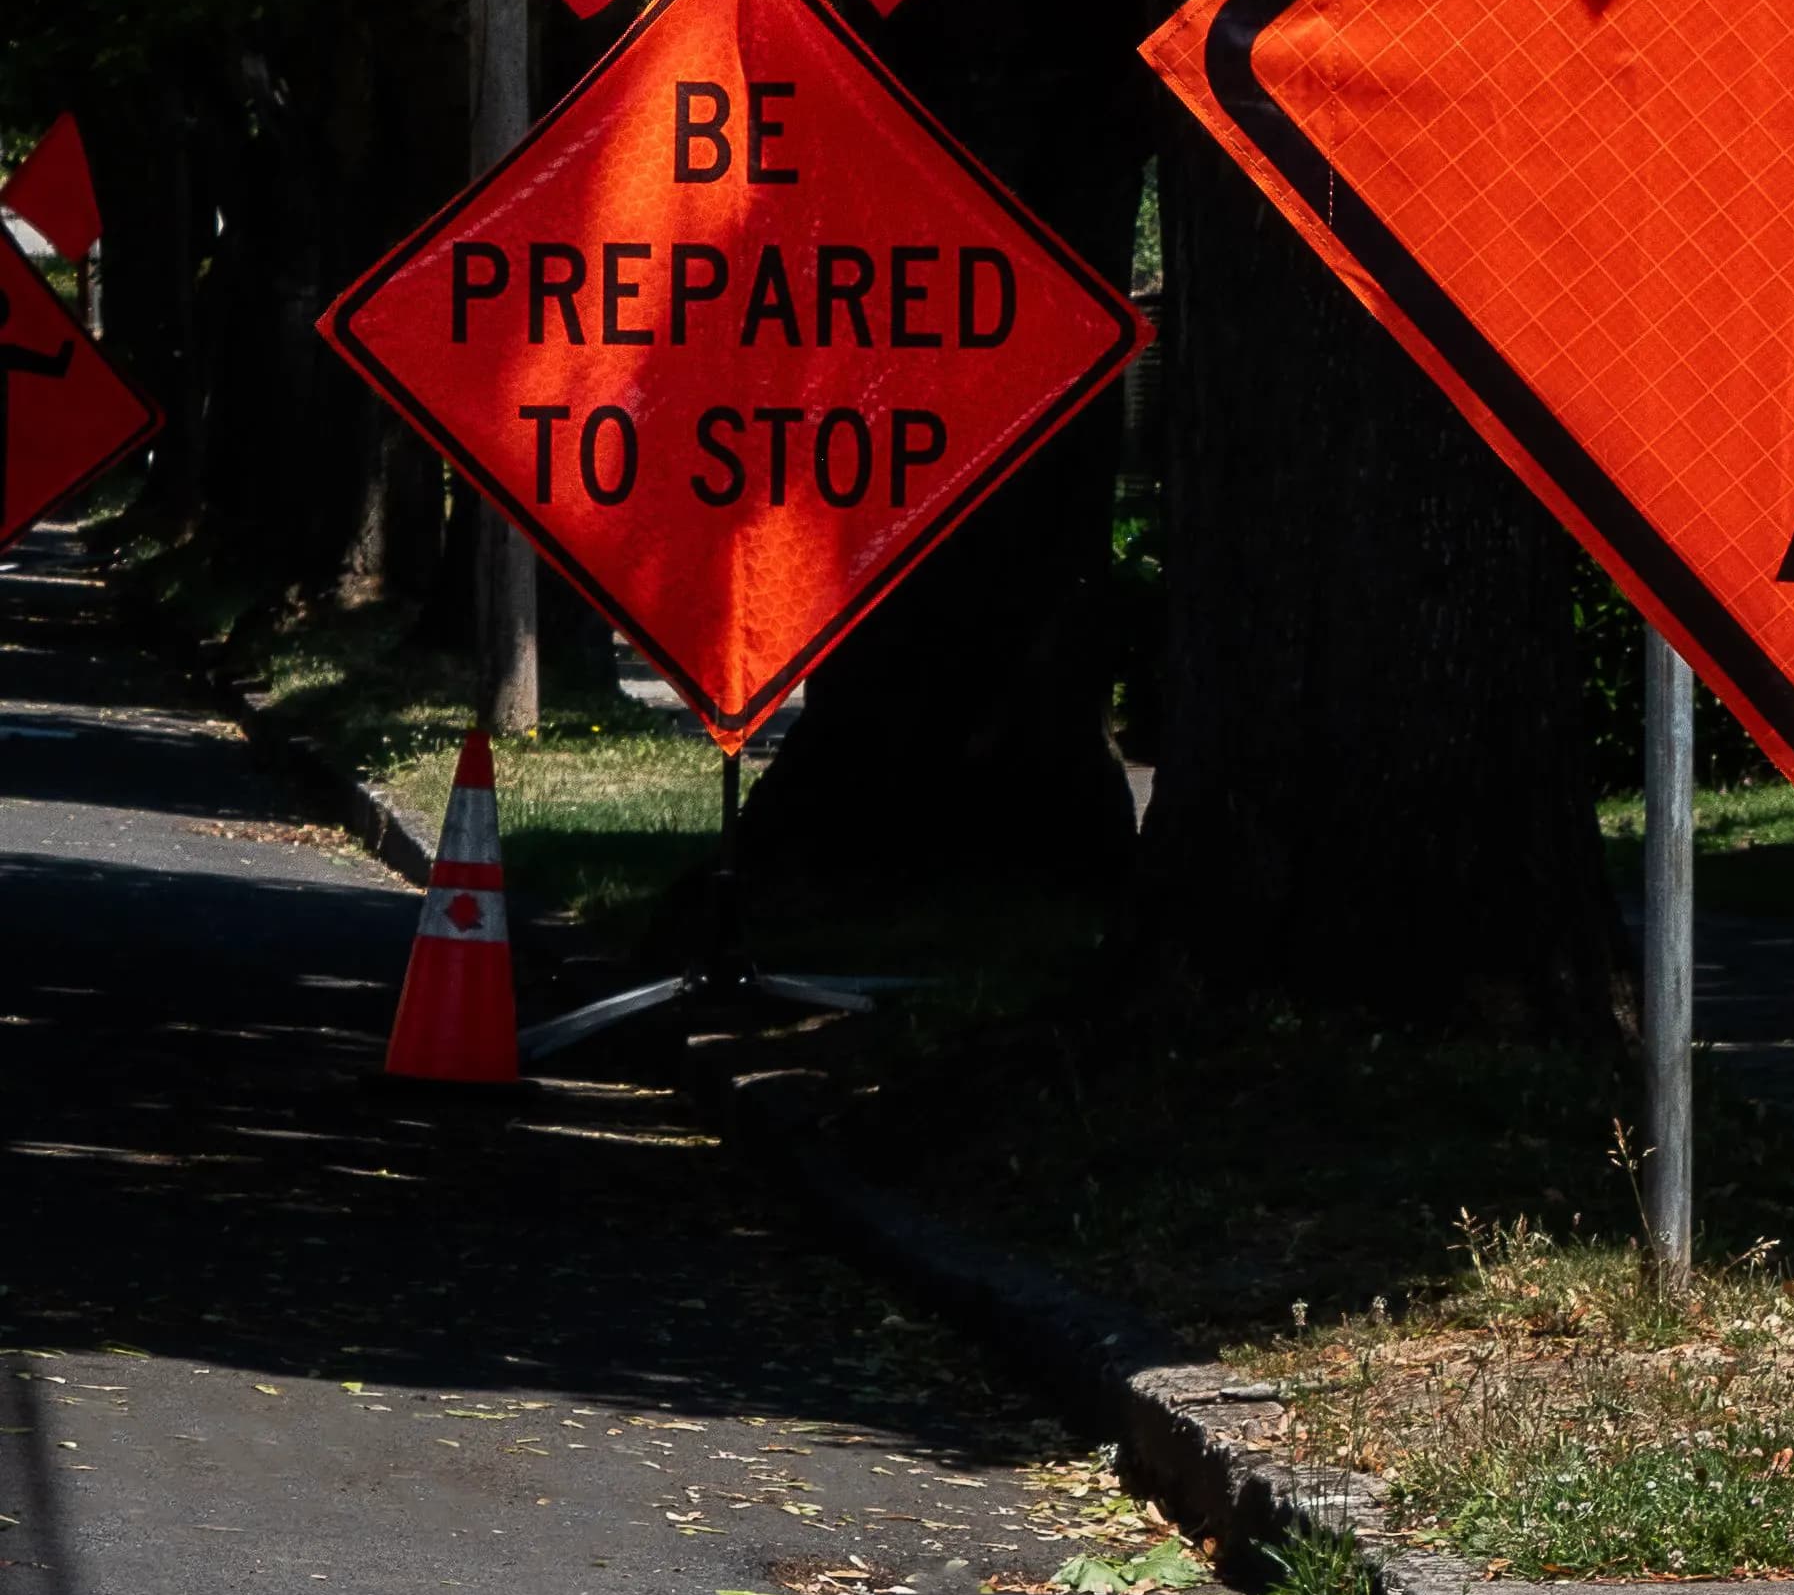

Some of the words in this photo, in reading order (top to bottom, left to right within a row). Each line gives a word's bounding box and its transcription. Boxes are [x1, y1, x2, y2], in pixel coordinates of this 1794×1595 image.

[674, 81, 799, 185] BE
[451, 241, 1017, 349] PREPARED
[520, 406, 639, 506] TO
[690, 405, 948, 509] STOP
